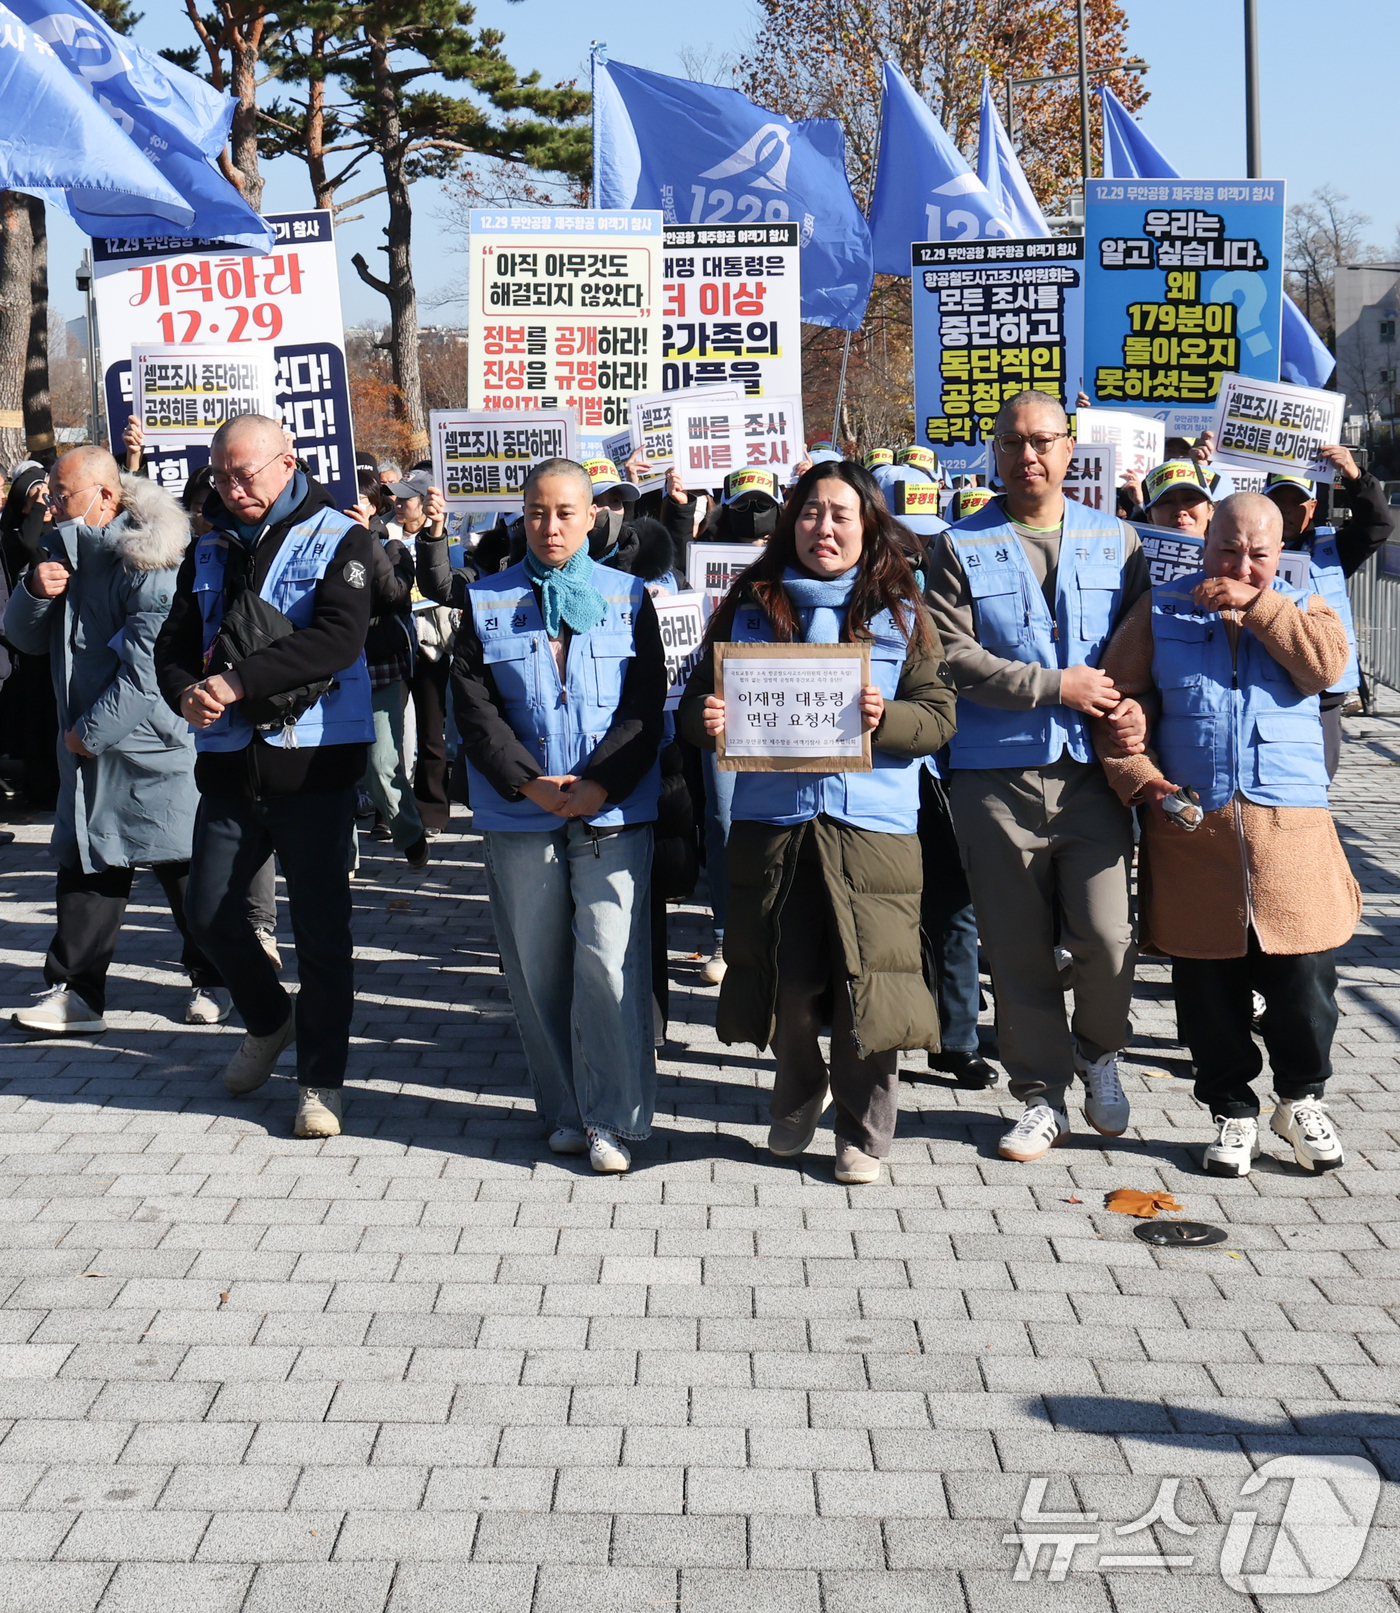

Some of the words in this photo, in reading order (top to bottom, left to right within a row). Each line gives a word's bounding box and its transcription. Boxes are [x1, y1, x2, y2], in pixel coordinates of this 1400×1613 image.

[1096, 186, 1124, 200] 12.29
[1127, 186, 1169, 200] 무안공항
[1172, 187, 1214, 201] 제주항공
[1217, 187, 1249, 201] 여객기
[1252, 187, 1274, 201] 참사
[292, 219, 320, 238] 참사
[480, 216, 508, 229] 12.29
[510, 216, 551, 230] 무안공항
[554, 216, 595, 230] 제주항공
[598, 217, 628, 231] 여객기
[631, 217, 652, 231] 참사
[697, 231, 736, 244] 제주항공
[738, 230, 767, 243] 여객기
[768, 229, 789, 242] 참사
[1146, 211, 1220, 237] 우리는
[497, 253, 537, 277] 아직
[545, 253, 629, 278] 아무것도
[921, 249, 945, 261] 12.29
[948, 247, 985, 260] 무안공항
[987, 245, 1024, 258] 제주항공
[1026, 244, 1055, 257] 여객기
[1057, 243, 1077, 256] 참사
[1101, 240, 1150, 266] 알고
[1158, 240, 1263, 267] 싶습니다.
[703, 255, 785, 277] 대통령은
[925, 268, 1074, 288] 항공철도사고조사위원회는
[129, 253, 305, 307] 기억하라
[1167, 271, 1196, 300] 왜
[490, 282, 573, 306] 해결되지
[581, 283, 643, 307] 않았다
[700, 281, 767, 317] 이상
[940, 288, 985, 311] 모든
[991, 285, 1059, 309] 조사를
[940, 312, 1060, 346] 중단하고
[1129, 304, 1232, 333] 179분이
[483, 326, 547, 355] 정보를
[555, 326, 648, 356] 공개하라!
[1125, 337, 1235, 366] 돌아오지
[483, 360, 547, 390] 진상을
[555, 360, 648, 391] 규명하라!
[941, 347, 1061, 380] 독단적인
[144, 364, 197, 392] 셀프조사
[202, 364, 259, 391] 중단하라!
[145, 399, 198, 427] 공청회를
[688, 415, 730, 439] 빠른
[744, 412, 786, 437] 조사
[1228, 392, 1278, 424] 셀프조사
[1280, 402, 1330, 433] 중단하라!
[927, 417, 972, 441] 즉각
[1133, 429, 1157, 452] 조사
[1222, 422, 1272, 453] 공청회를
[445, 430, 498, 459] 셀프조사
[503, 429, 562, 459] 중단하라!
[689, 445, 731, 469] 바른
[746, 441, 790, 465] 조사
[942, 460, 967, 469] 1229
[447, 465, 500, 494] 공청회를
[505, 465, 536, 493] 연기
[966, 555, 982, 568] 진
[994, 548, 1009, 562] 상
[1075, 548, 1090, 560] 규
[1103, 548, 1116, 561] 명
[1142, 537, 1204, 566] 셀프조
[485, 617, 498, 631] 진
[513, 614, 527, 627] 상
[738, 691, 785, 707] 이재명
[795, 691, 844, 707] 대통령
[747, 712, 779, 728] 면담
[787, 712, 836, 728] 요청서
